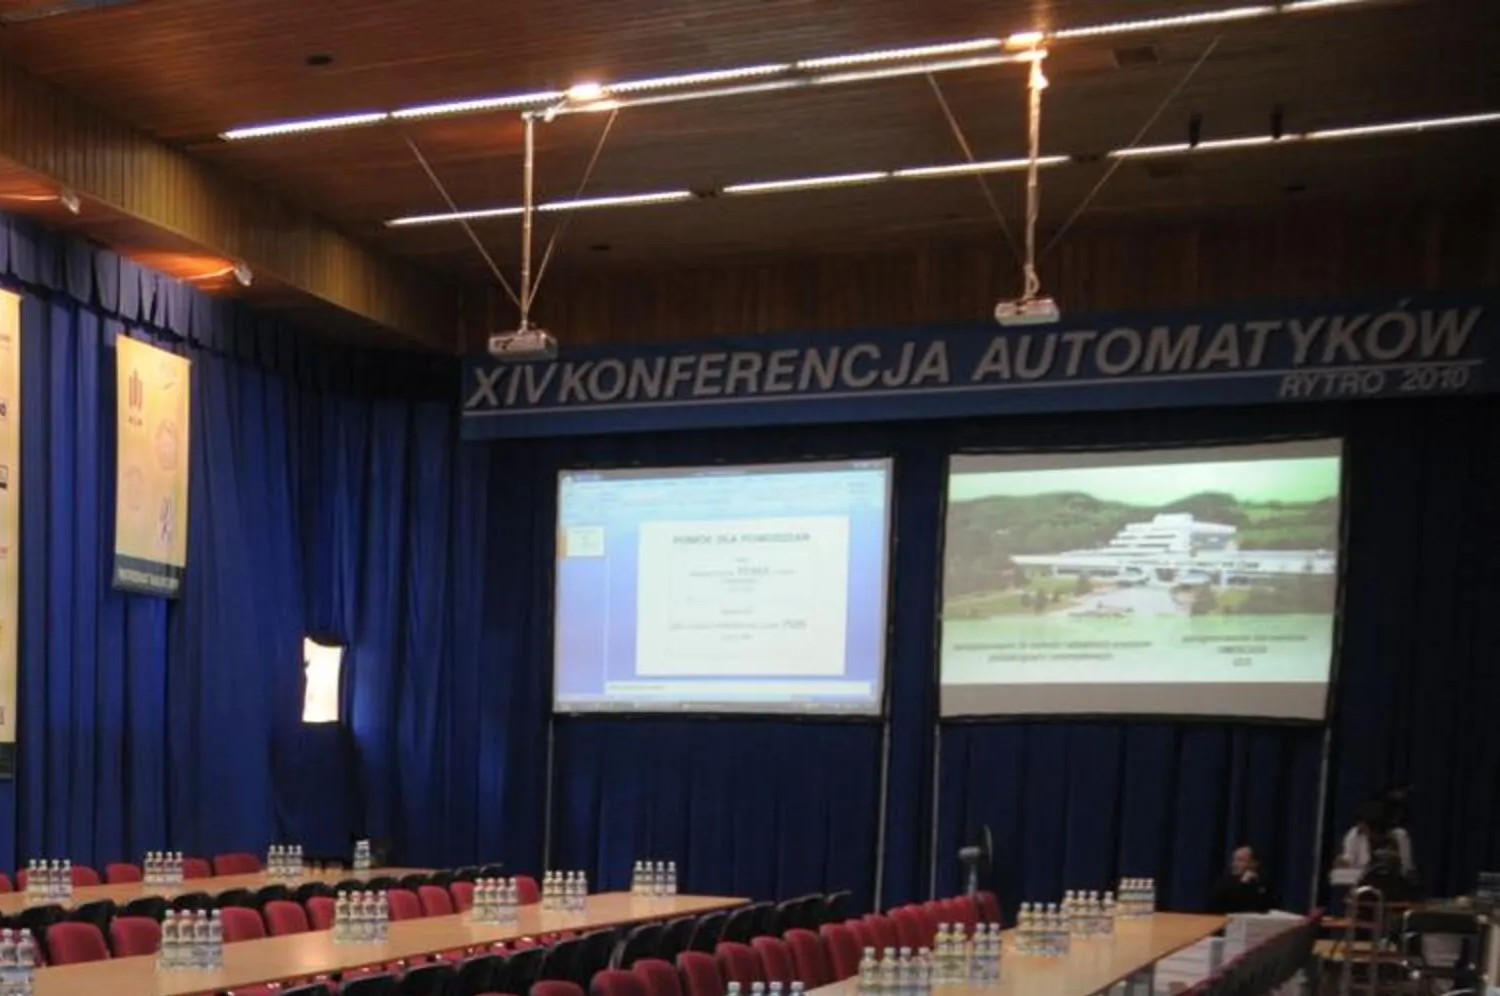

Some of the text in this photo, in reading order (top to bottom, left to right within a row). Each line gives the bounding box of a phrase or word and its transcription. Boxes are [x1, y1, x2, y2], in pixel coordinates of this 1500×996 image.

[468, 299, 1484, 409] XIV KONFERENCJA AUTOMATYKÓW
[1279, 365, 1472, 399] RYTRO 2010
